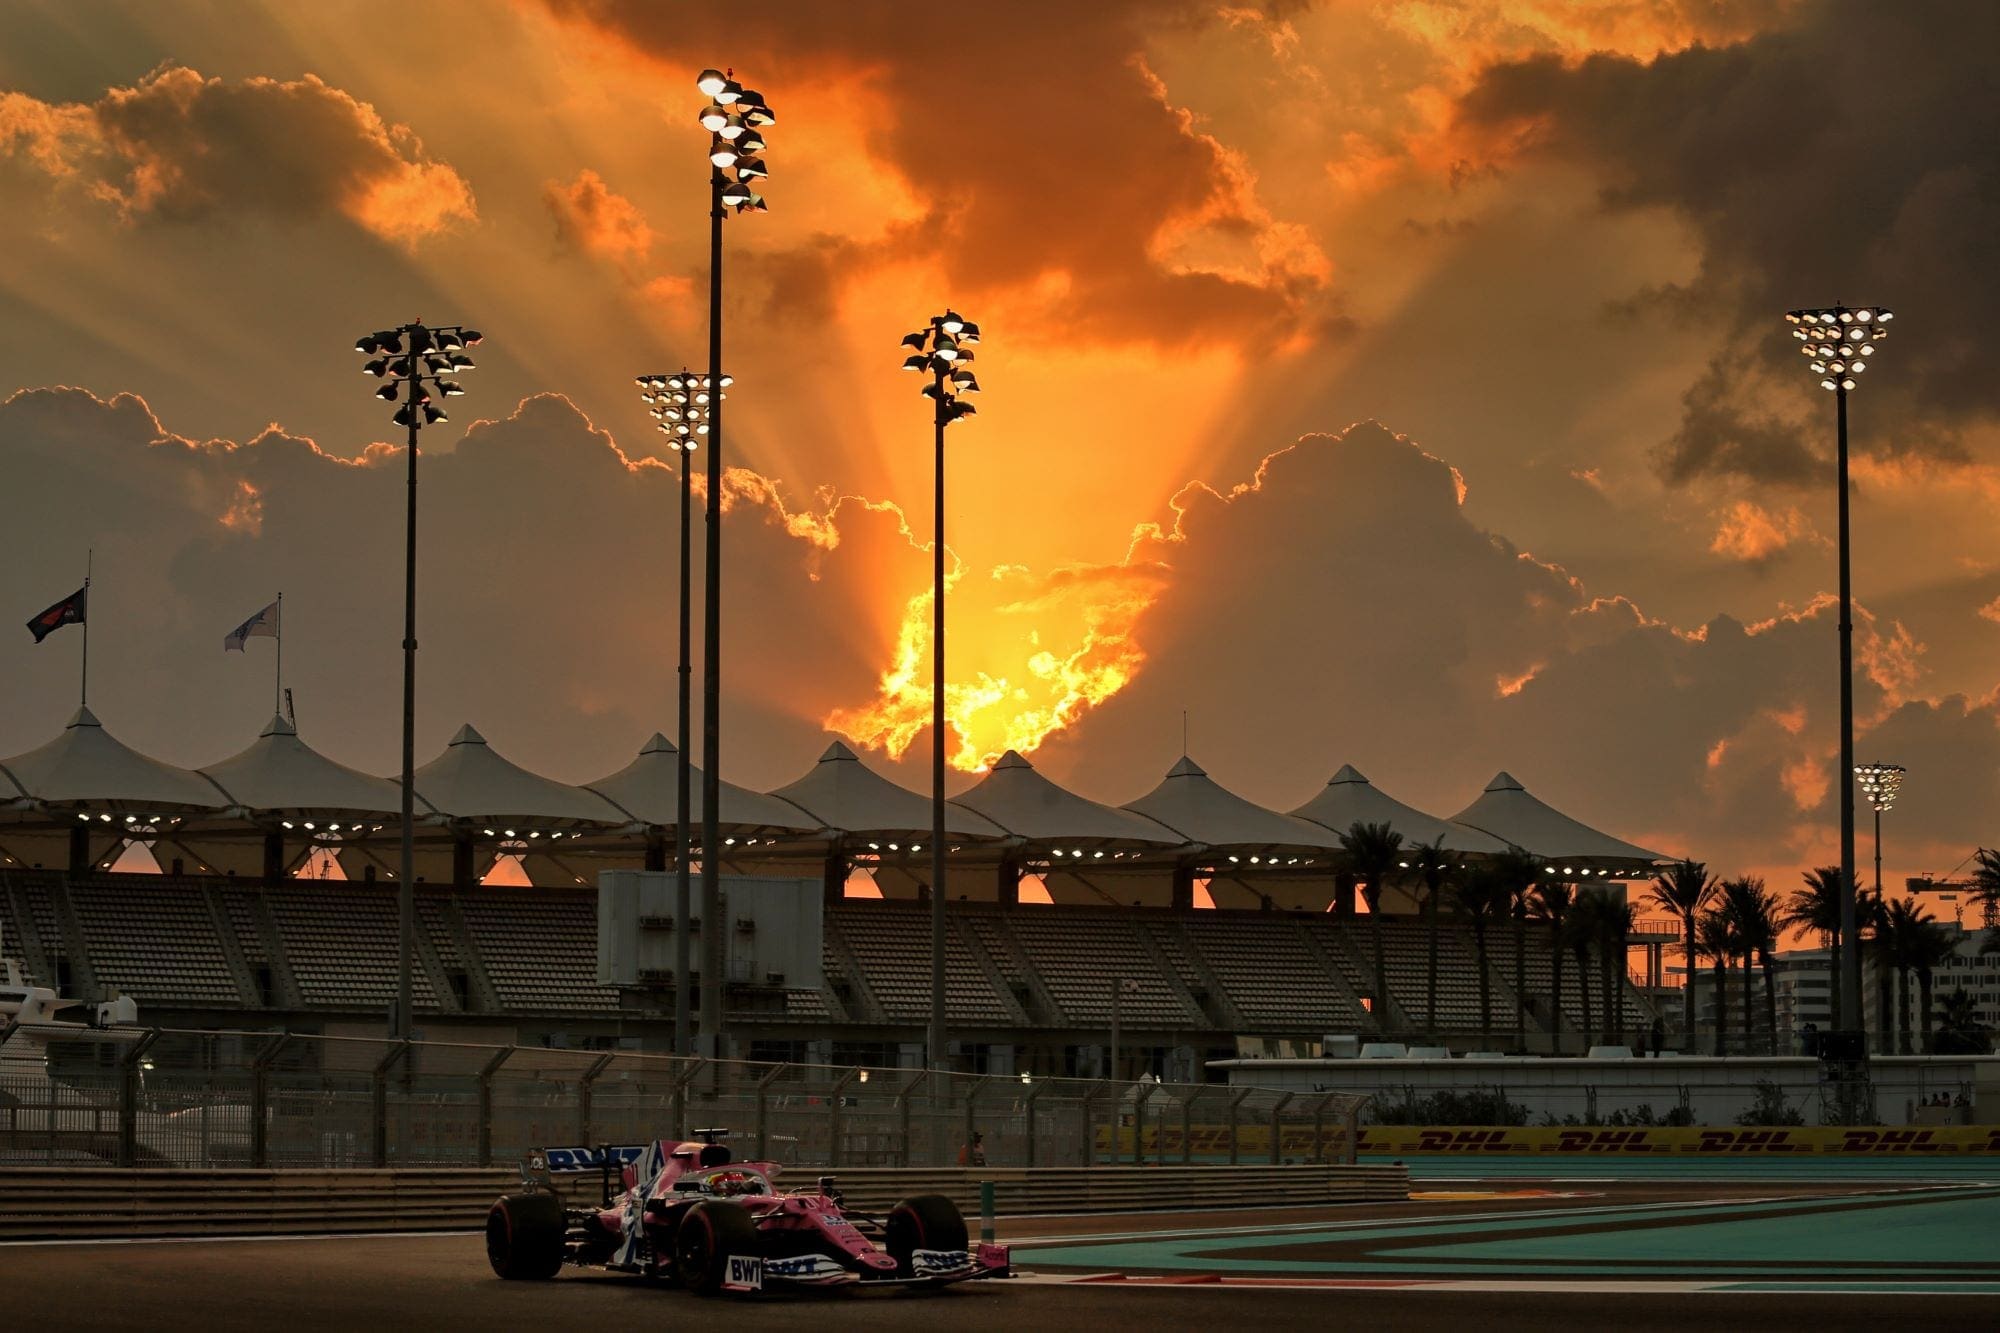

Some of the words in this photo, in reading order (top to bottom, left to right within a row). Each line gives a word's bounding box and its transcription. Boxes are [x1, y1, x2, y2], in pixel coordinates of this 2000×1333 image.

[1418, 1131, 1512, 1150] DHL
[1558, 1131, 1653, 1151] DHL
[1700, 1131, 1799, 1152] DHL
[1841, 1131, 1939, 1152] DHL
[731, 1260, 761, 1282] BWT
